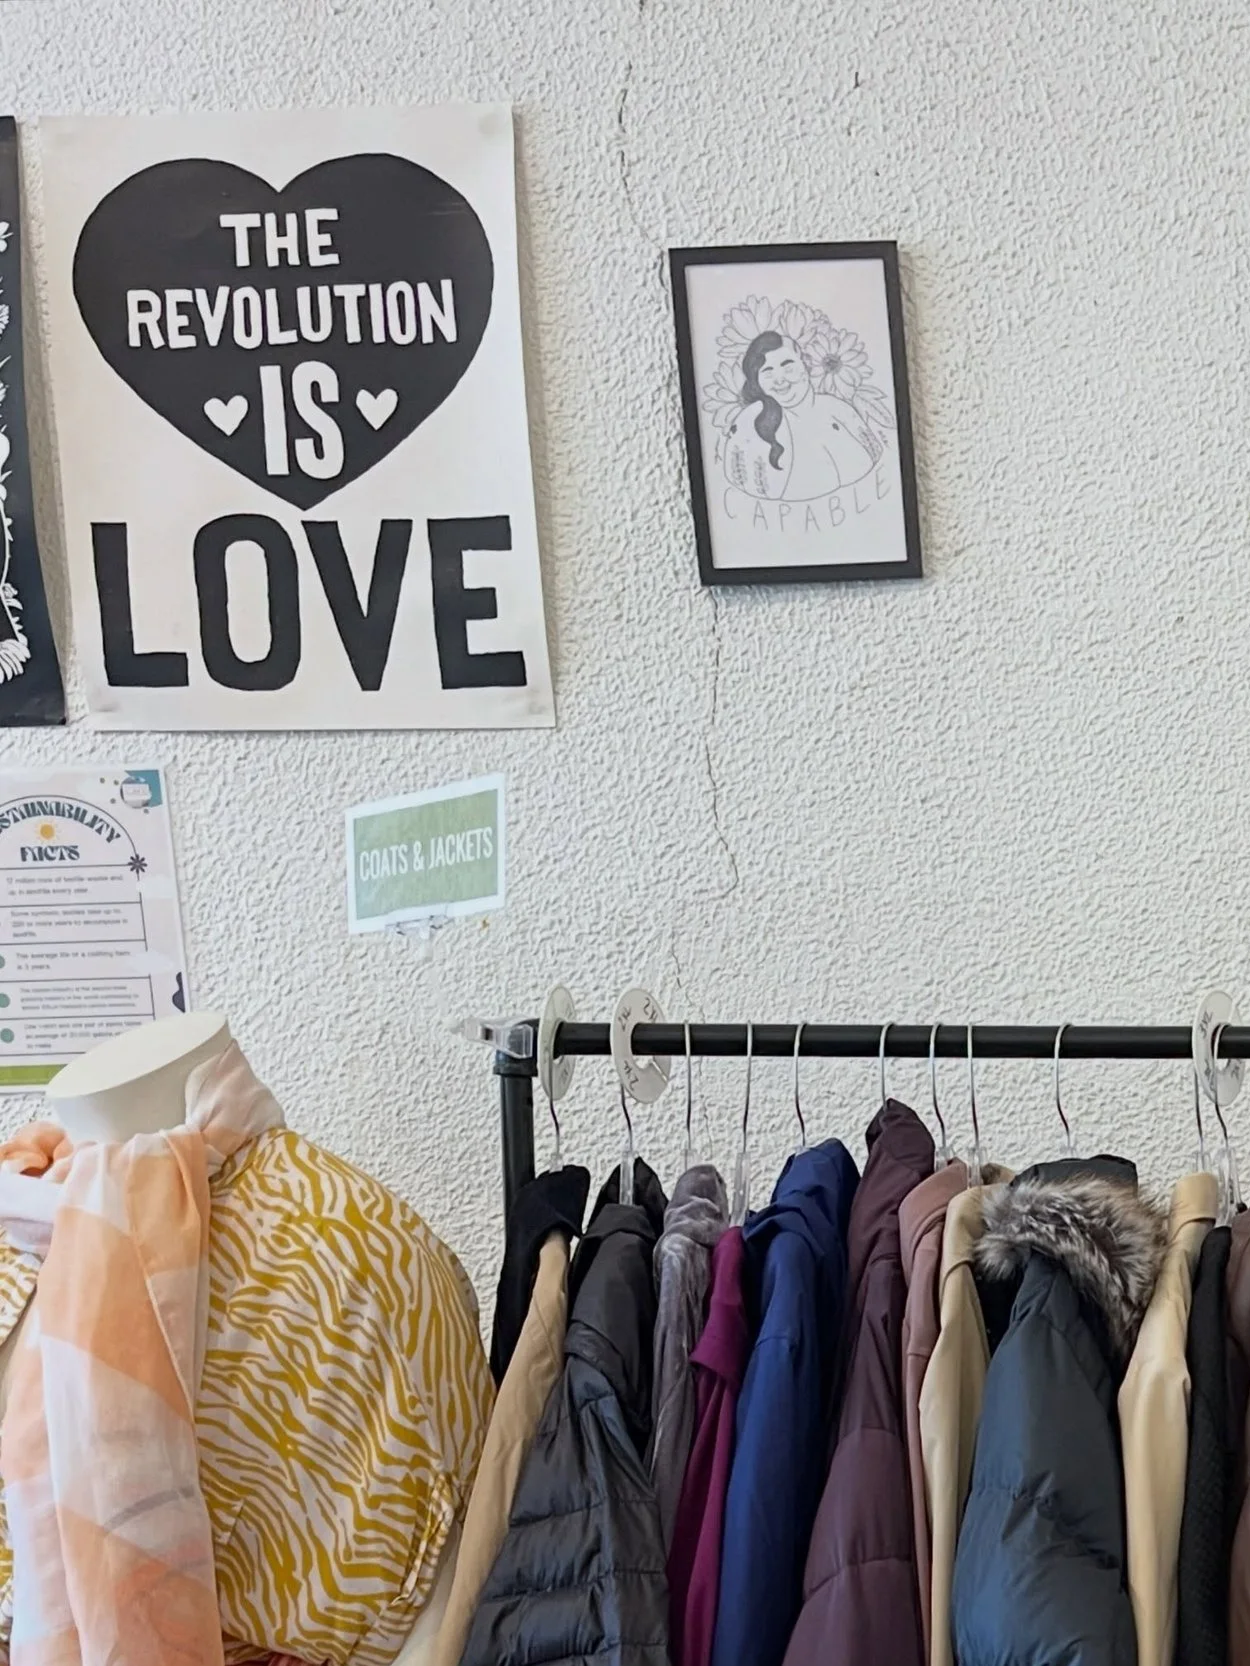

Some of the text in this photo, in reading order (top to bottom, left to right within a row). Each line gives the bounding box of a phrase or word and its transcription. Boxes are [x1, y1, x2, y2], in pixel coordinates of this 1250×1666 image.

[218, 207, 341, 268] THE
[126, 279, 459, 350] REVOLUTION
[259, 360, 345, 480] IS
[723, 463, 892, 533] CAPABLE
[90, 513, 528, 692] LOVE
[0, 800, 121, 843] STAINABILITY
[20, 845, 80, 862] FACTS
[359, 826, 493, 882] COATS & JACKETS
